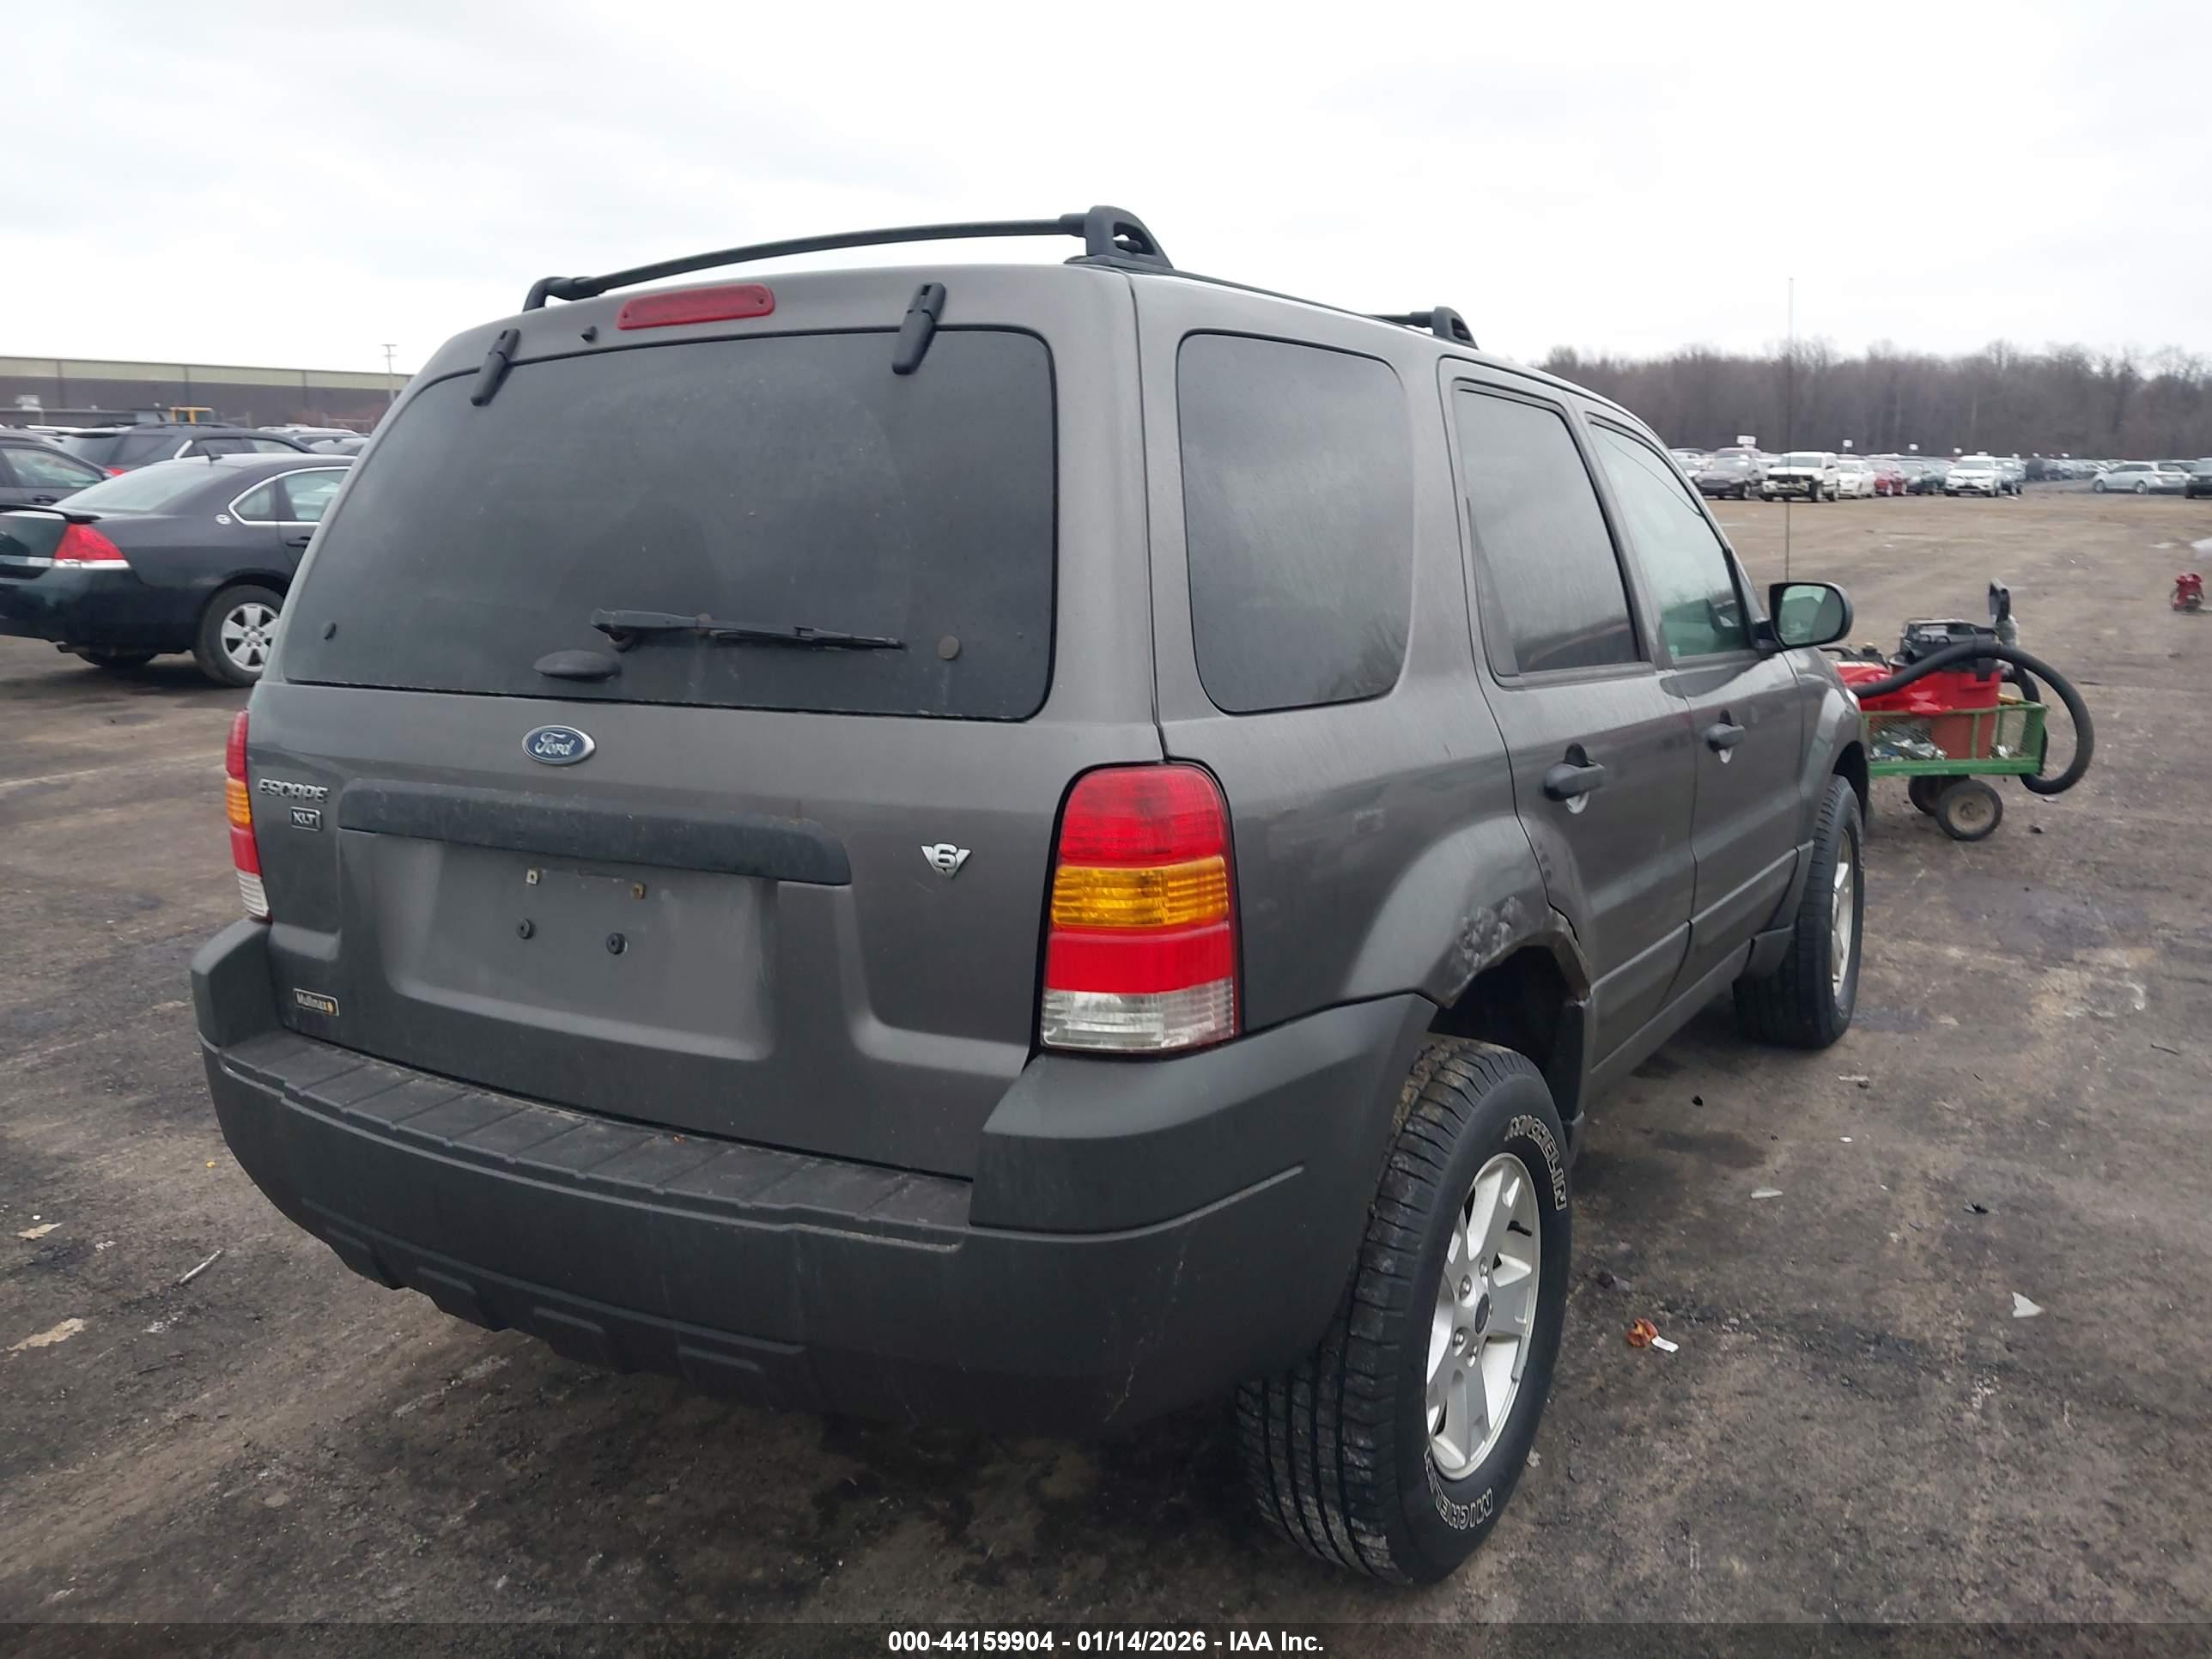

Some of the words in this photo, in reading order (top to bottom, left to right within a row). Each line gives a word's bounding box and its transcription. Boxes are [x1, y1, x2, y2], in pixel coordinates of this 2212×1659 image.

[534, 731, 576, 756] Ford
[258, 777, 330, 804] ESCAPE
[292, 810, 316, 825] XLT
[1504, 1115, 1567, 1212] MICHELIN
[1424, 1444, 1493, 1530] MICHELIN
